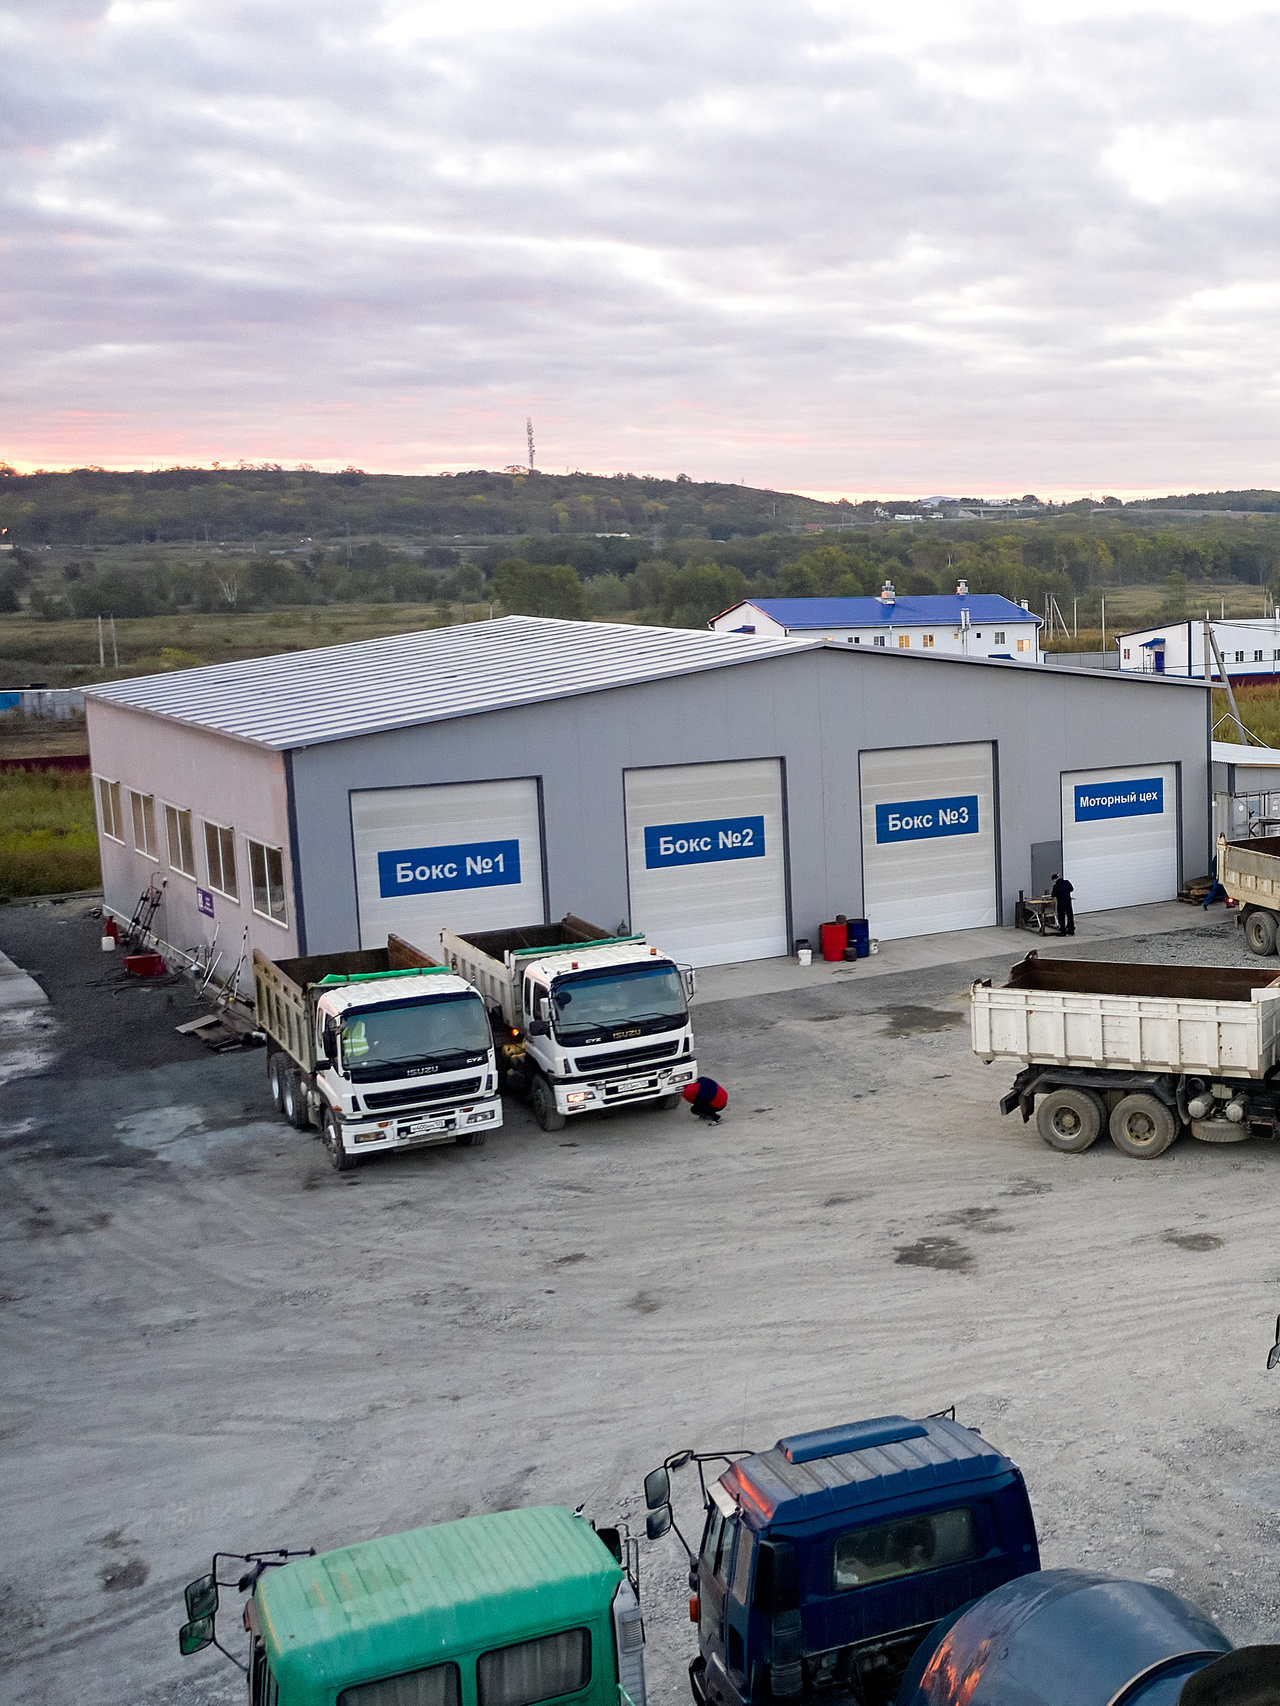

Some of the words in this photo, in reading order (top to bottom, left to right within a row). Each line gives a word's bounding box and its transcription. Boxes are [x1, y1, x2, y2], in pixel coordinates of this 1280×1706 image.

[1080, 791, 1137, 808] Моторный
[1139, 791, 1158, 803] цех
[888, 813, 933, 832] Бокс
[938, 806, 969, 826] №3
[660, 836, 712, 856] Бокс
[718, 828, 754, 849] №2
[396, 861, 458, 883] Бокс
[465, 853, 505, 876] №1
[612, 1028, 642, 1039] ISUZU
[407, 1065, 439, 1077] ISUZU
